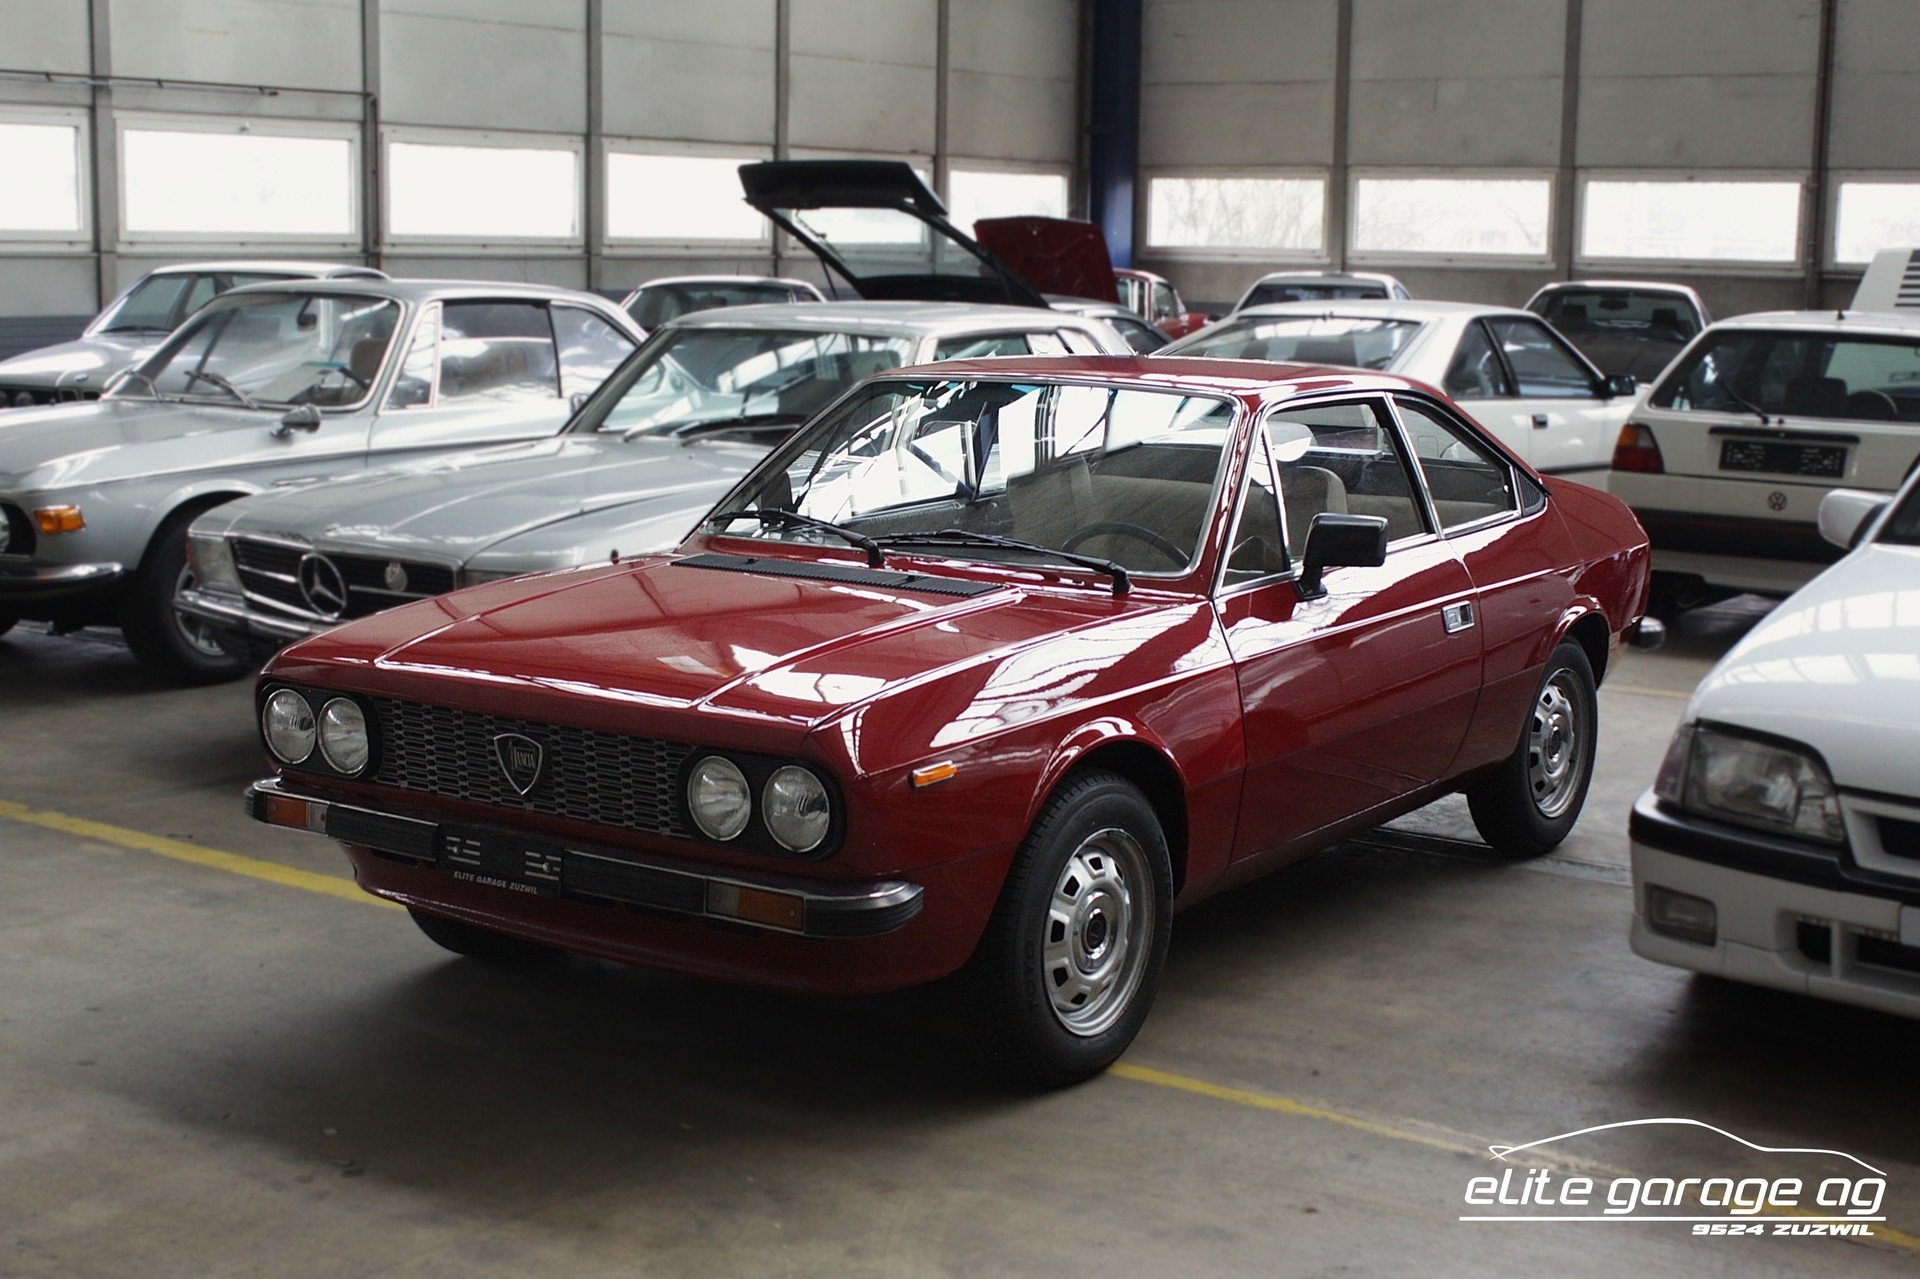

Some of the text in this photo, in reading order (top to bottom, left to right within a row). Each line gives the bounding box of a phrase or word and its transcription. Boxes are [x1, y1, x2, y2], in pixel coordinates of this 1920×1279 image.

[1767, 491, 1787, 511] VW
[453, 871, 538, 895] ELITE GARAGE ZUZWIL
